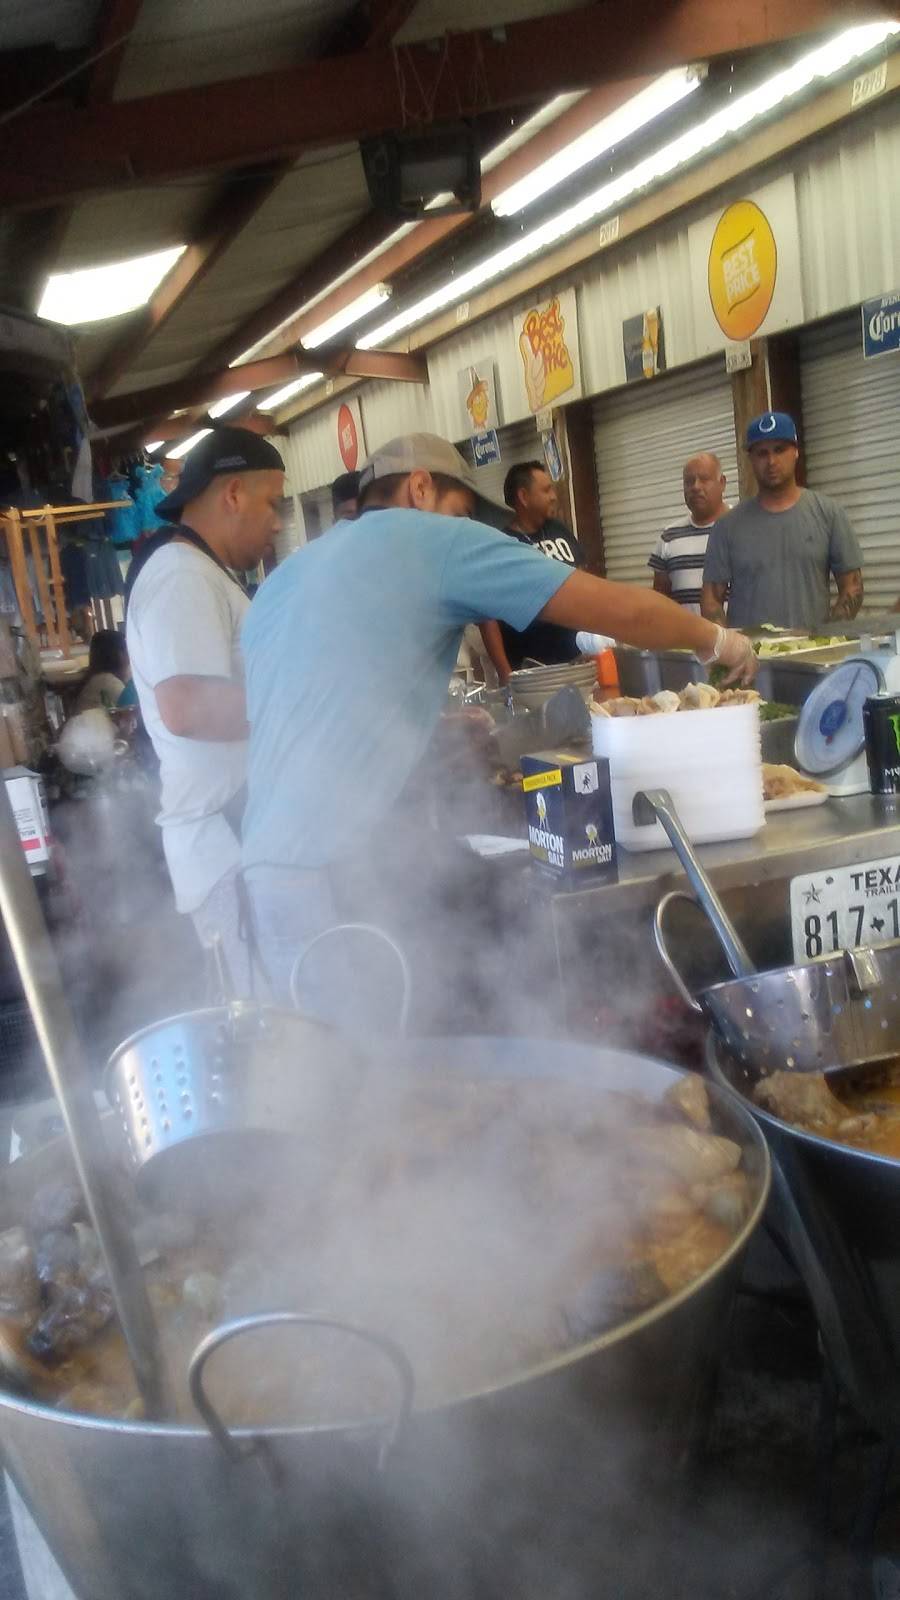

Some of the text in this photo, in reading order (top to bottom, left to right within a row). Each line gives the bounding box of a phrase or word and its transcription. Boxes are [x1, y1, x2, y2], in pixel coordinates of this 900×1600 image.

[723, 237, 755, 279] BEST
[727, 261, 761, 304] PRICE
[529, 825, 564, 855] MORTON
[572, 843, 612, 861] MORTON
[548, 851, 564, 867] SALT
[597, 854, 611, 864] SALT
